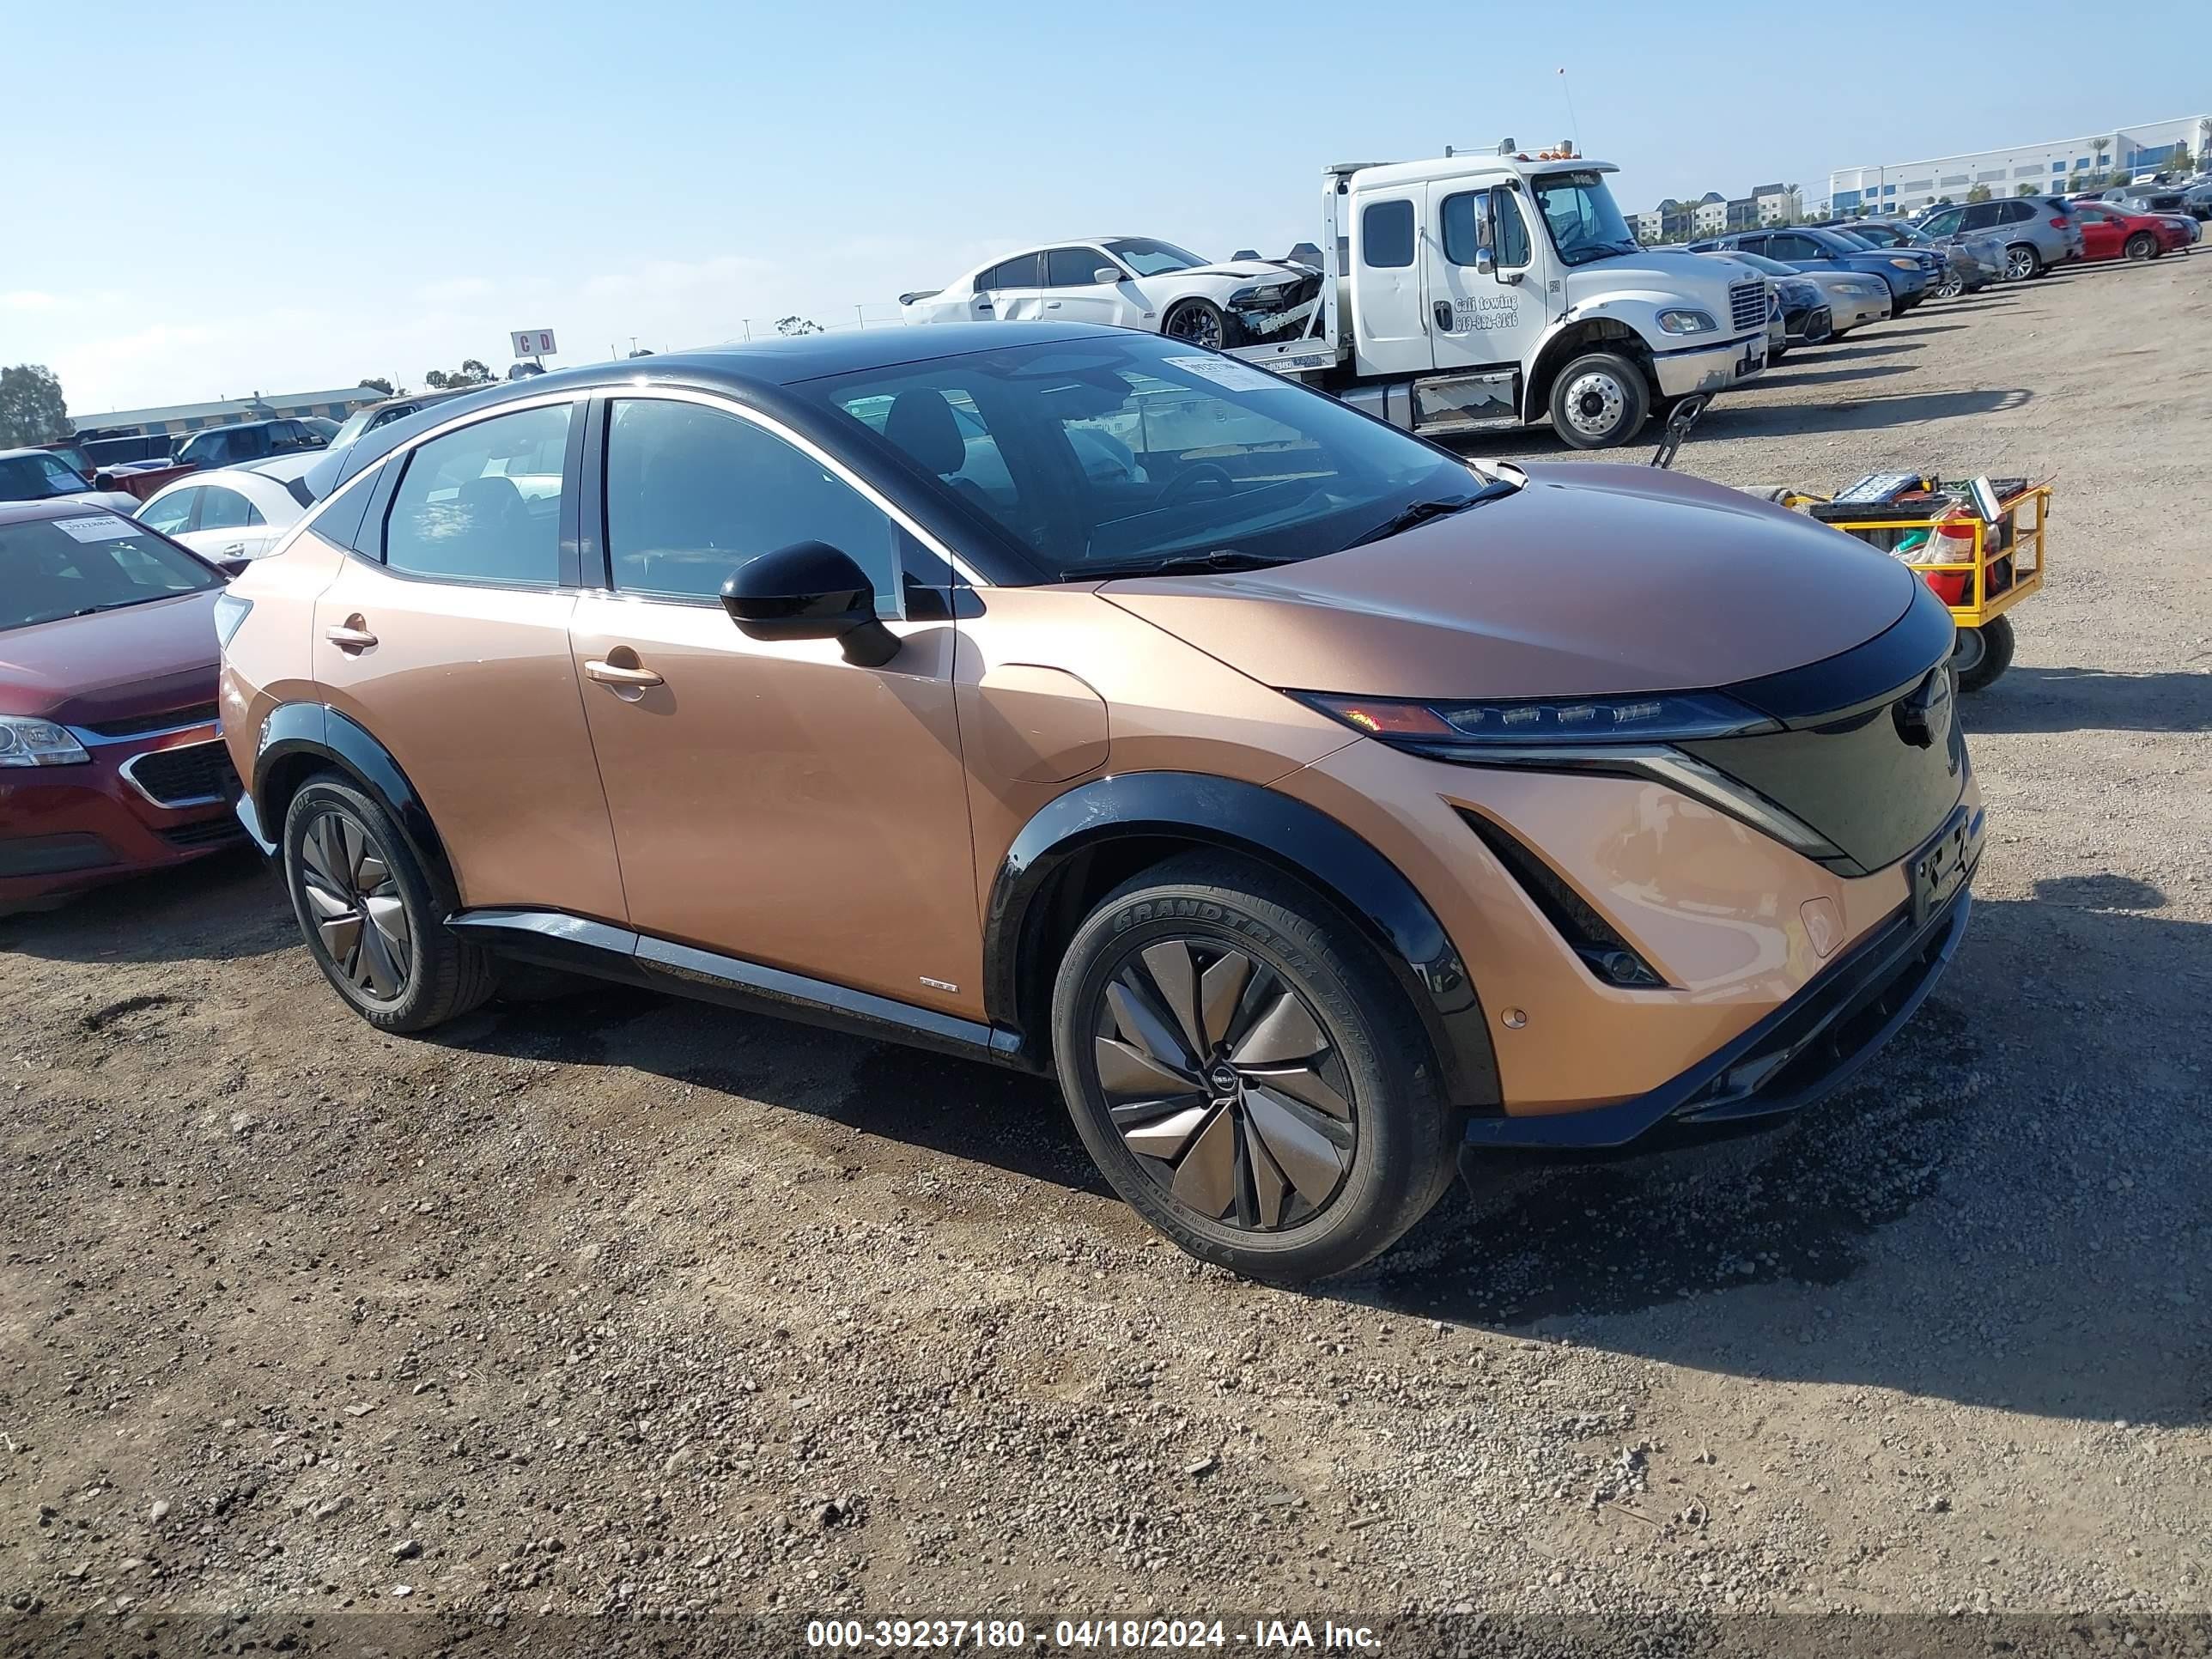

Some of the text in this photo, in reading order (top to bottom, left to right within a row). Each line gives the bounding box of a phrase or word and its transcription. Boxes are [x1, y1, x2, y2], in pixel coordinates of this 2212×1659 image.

[1454, 294, 1519, 313] Cali towing
[520, 333, 550, 352] C D
[1114, 900, 1320, 981] GRANDTREK
[1211, 1075, 1238, 1084] NISSAN
